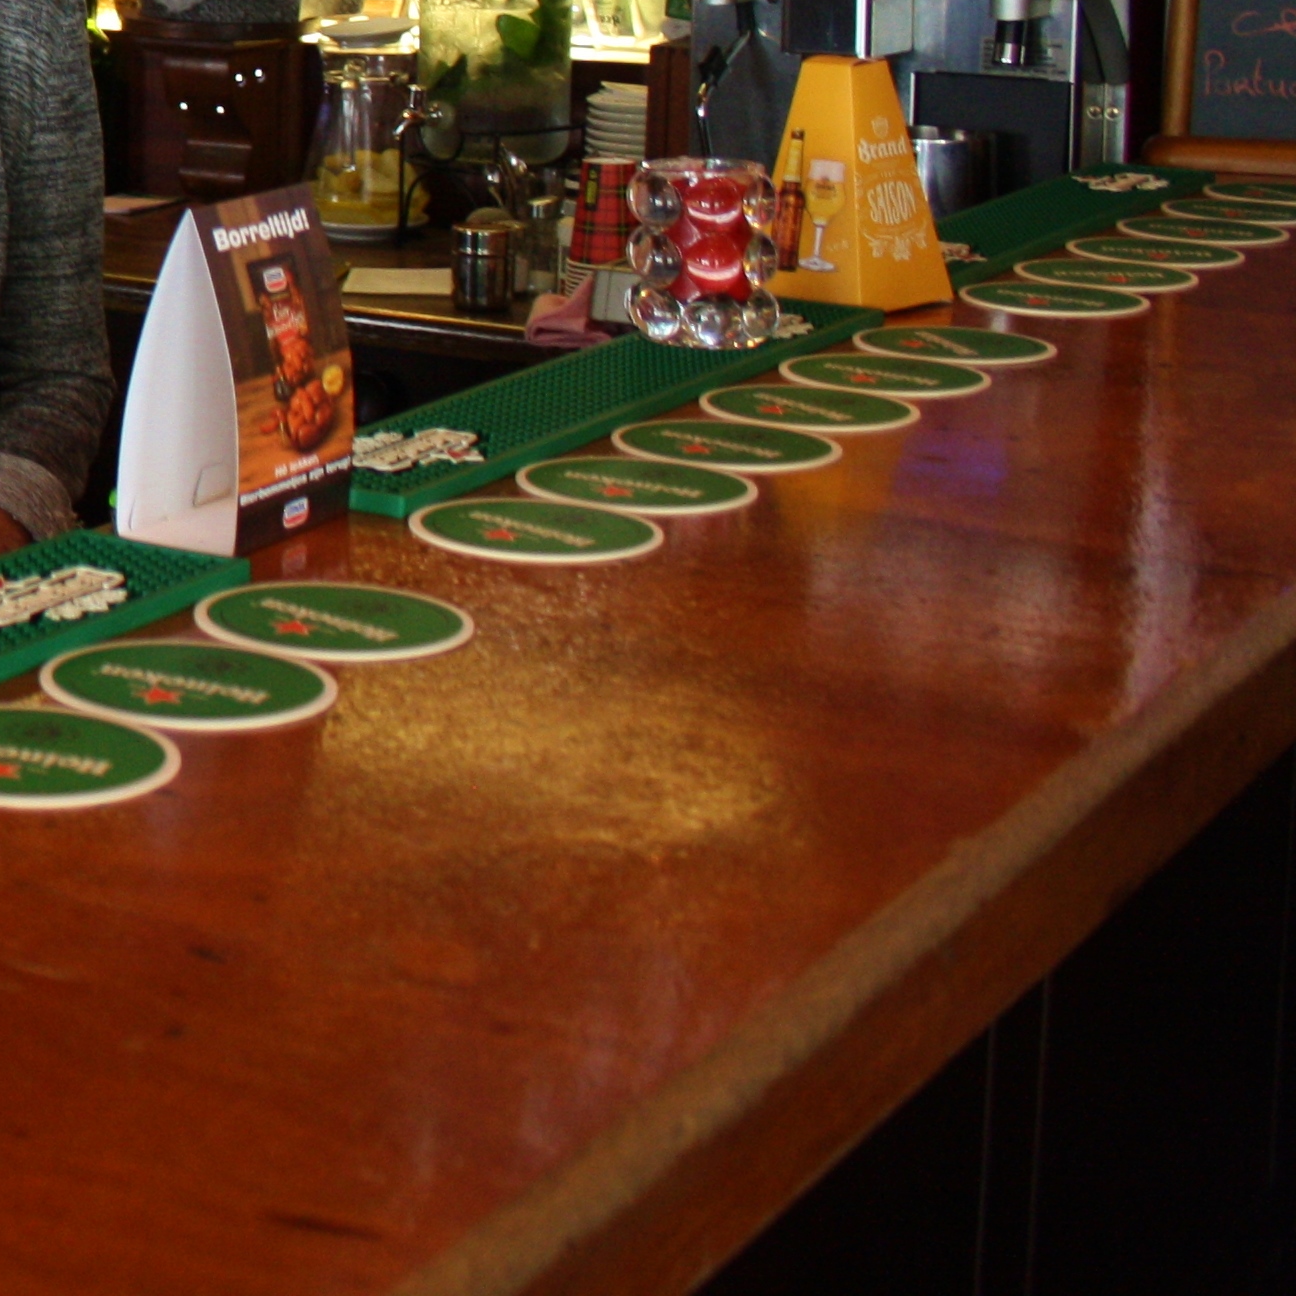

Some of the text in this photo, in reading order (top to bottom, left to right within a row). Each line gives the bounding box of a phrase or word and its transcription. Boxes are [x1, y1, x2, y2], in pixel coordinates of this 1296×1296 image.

[857, 134, 908, 165] Brand
[866, 180, 917, 226] SAISON
[212, 207, 311, 253] Borreltijd!
